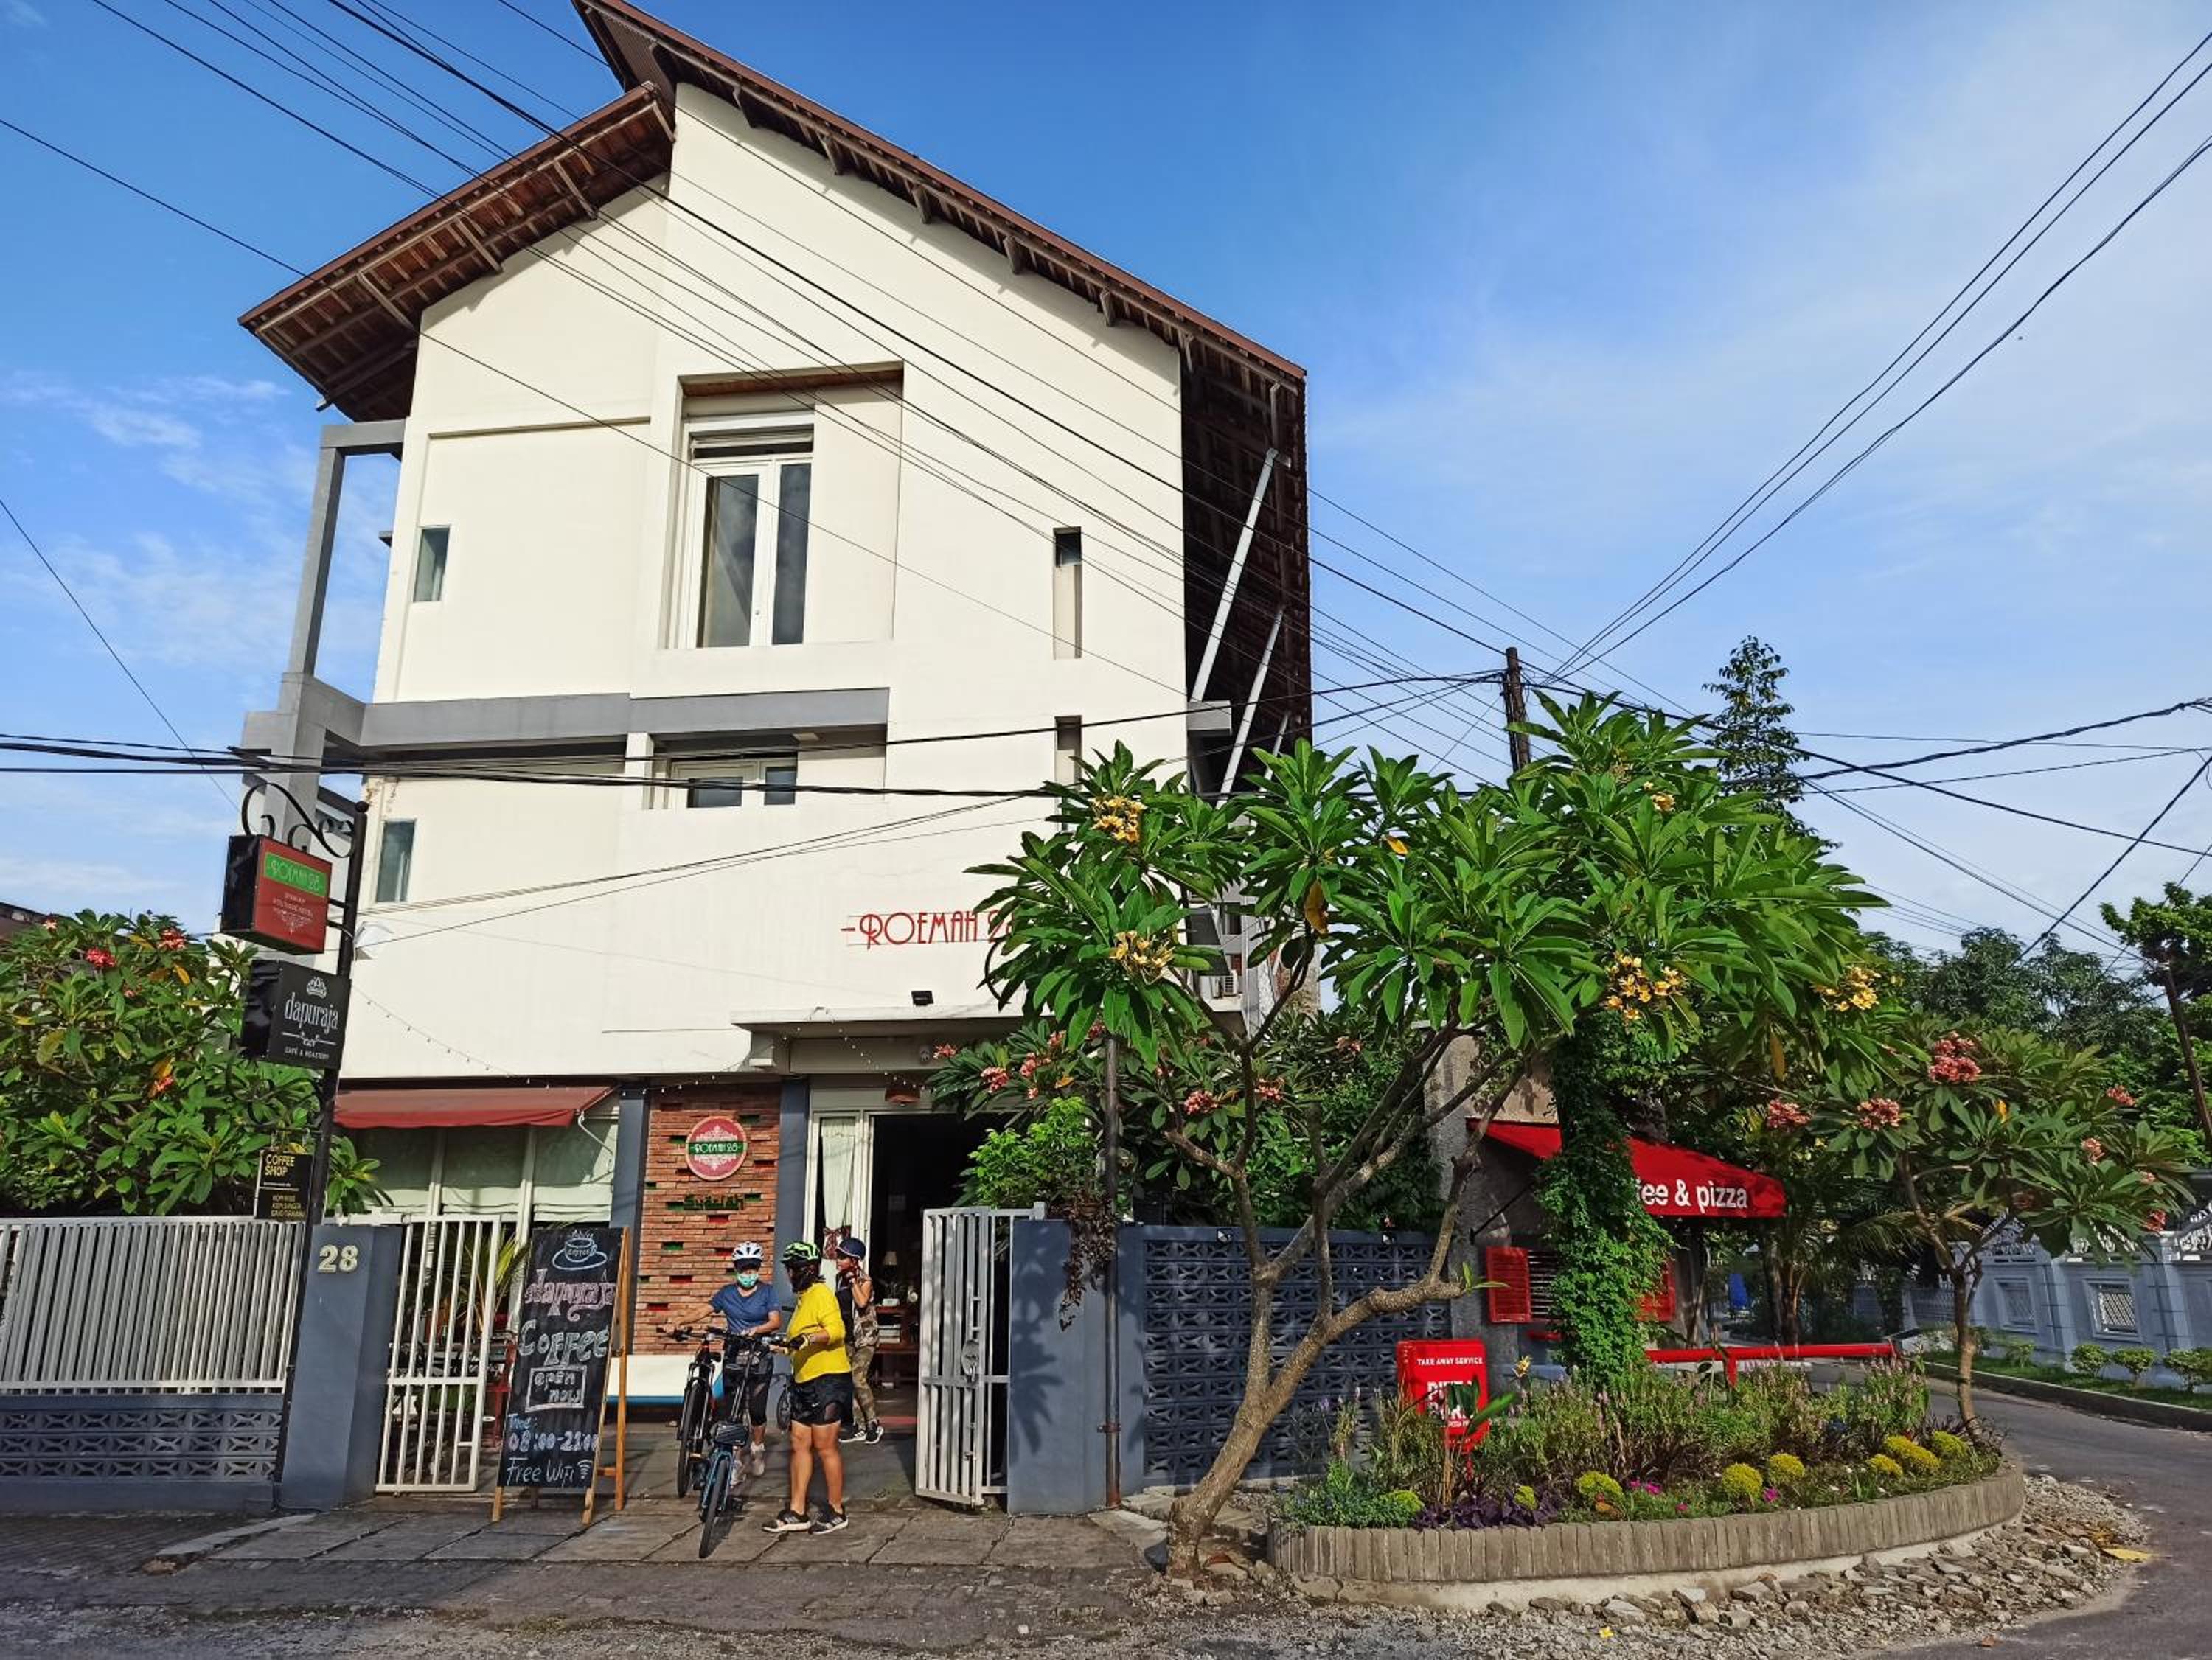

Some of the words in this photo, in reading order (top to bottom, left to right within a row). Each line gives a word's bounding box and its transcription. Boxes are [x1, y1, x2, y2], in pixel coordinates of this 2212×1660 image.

[859, 910, 978, 950] ROEMAH
[987, 910, 1015, 944] 2
[285, 991, 338, 1035] dapuraja
[265, 1154, 295, 1167] COFFEE
[265, 1165, 288, 1176] SHOP
[1674, 1179, 1692, 1207] &
[1696, 1180, 1748, 1214] pizza
[317, 1244, 359, 1274] 28
[507, 1457, 542, 1487] Free
